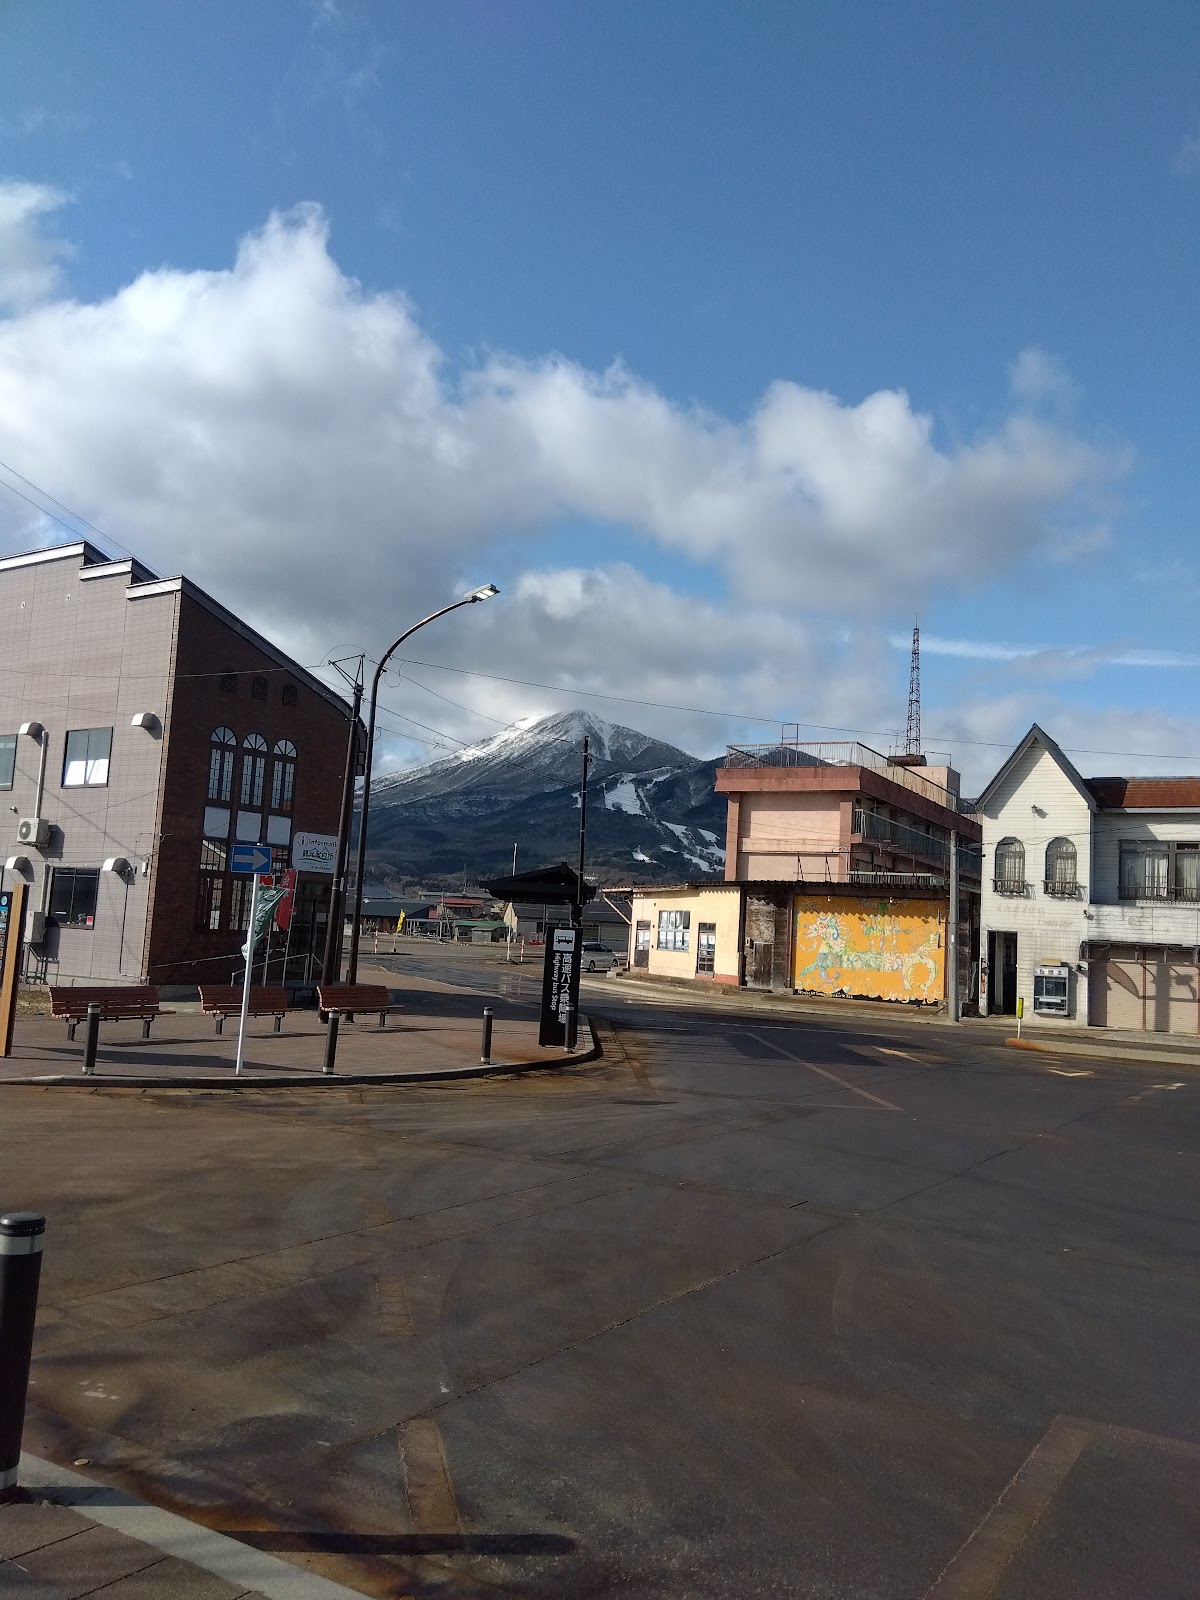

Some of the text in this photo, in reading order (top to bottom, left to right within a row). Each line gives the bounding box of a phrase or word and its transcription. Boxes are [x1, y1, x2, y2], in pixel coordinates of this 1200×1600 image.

[309, 839, 337, 847] Informati
[552, 953, 561, 982] Highway
[558, 953, 572, 1024] 高速バス乗降場
[550, 995, 558, 1011] Stop
